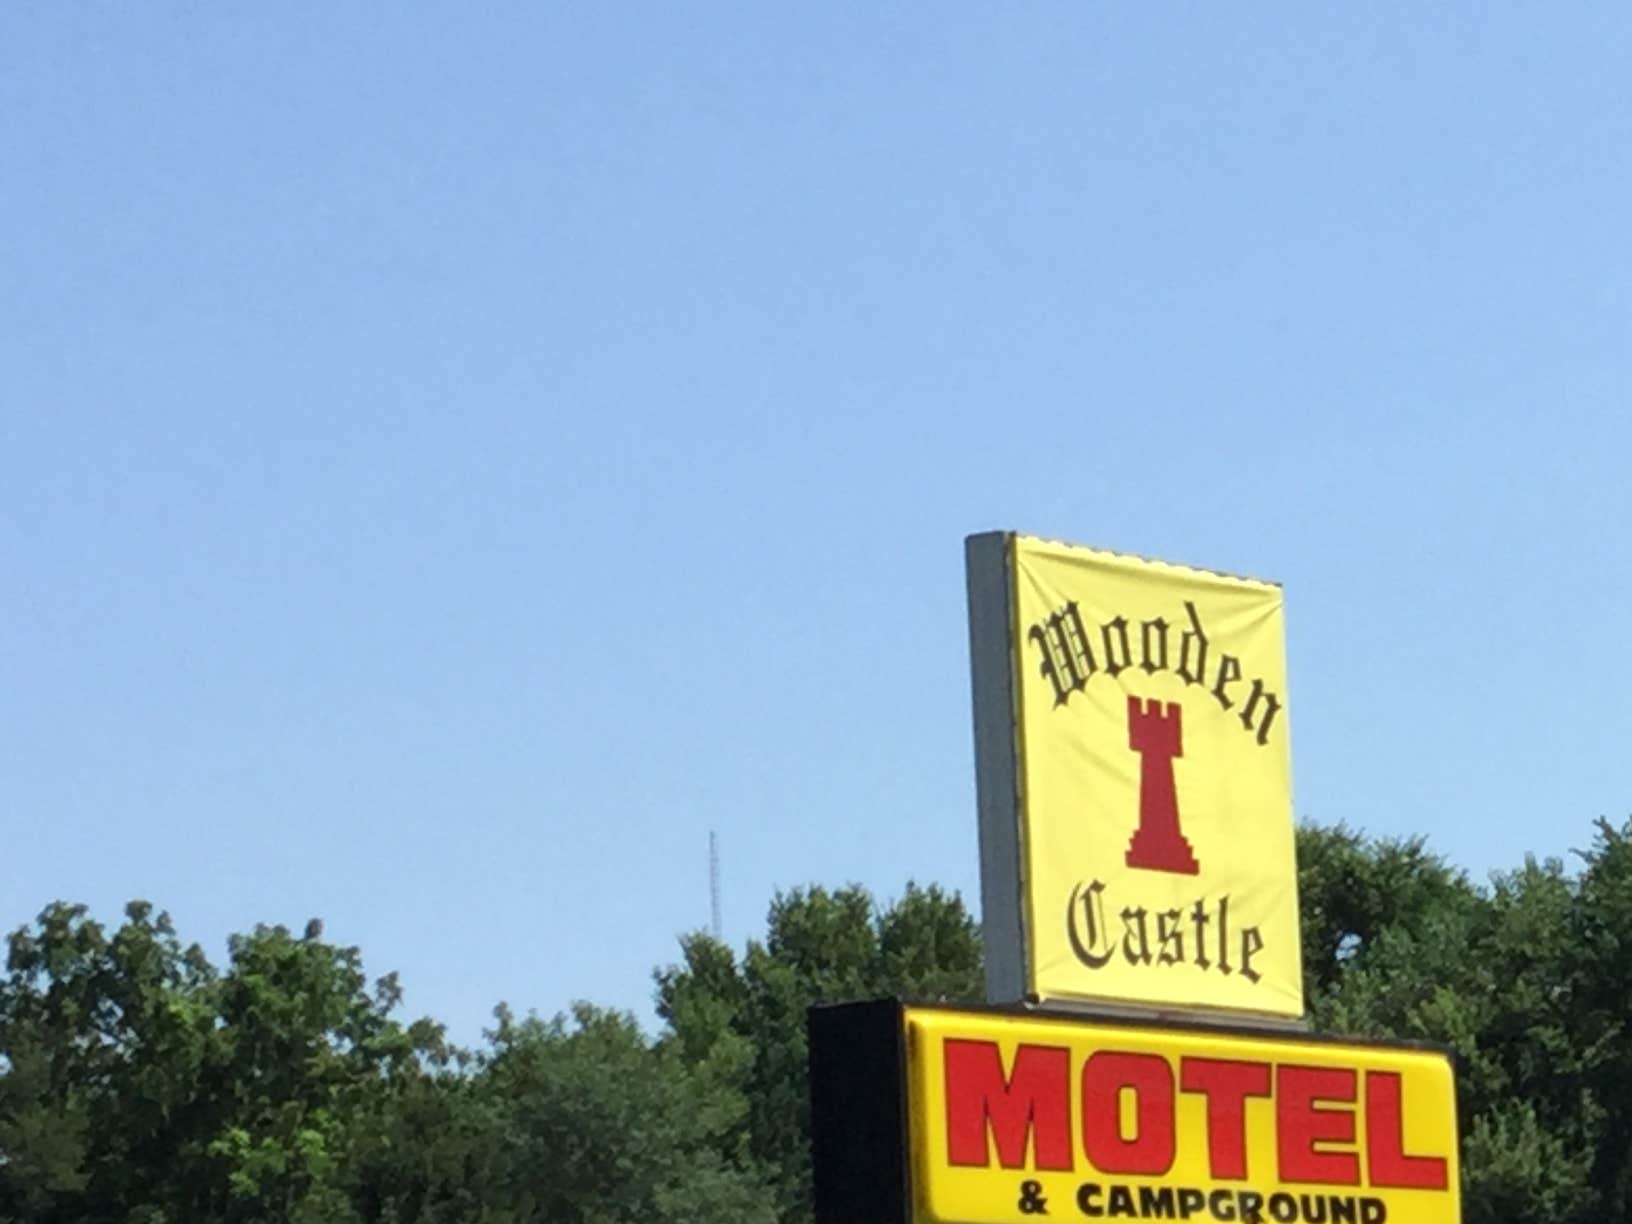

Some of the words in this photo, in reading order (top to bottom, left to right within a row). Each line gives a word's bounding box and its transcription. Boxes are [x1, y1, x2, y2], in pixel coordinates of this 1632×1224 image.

[1028, 601, 1281, 746] Wooden
[1067, 879, 1264, 984] Castle
[943, 1037, 1449, 1190] MOTEL
[1018, 1180, 1050, 1215] &
